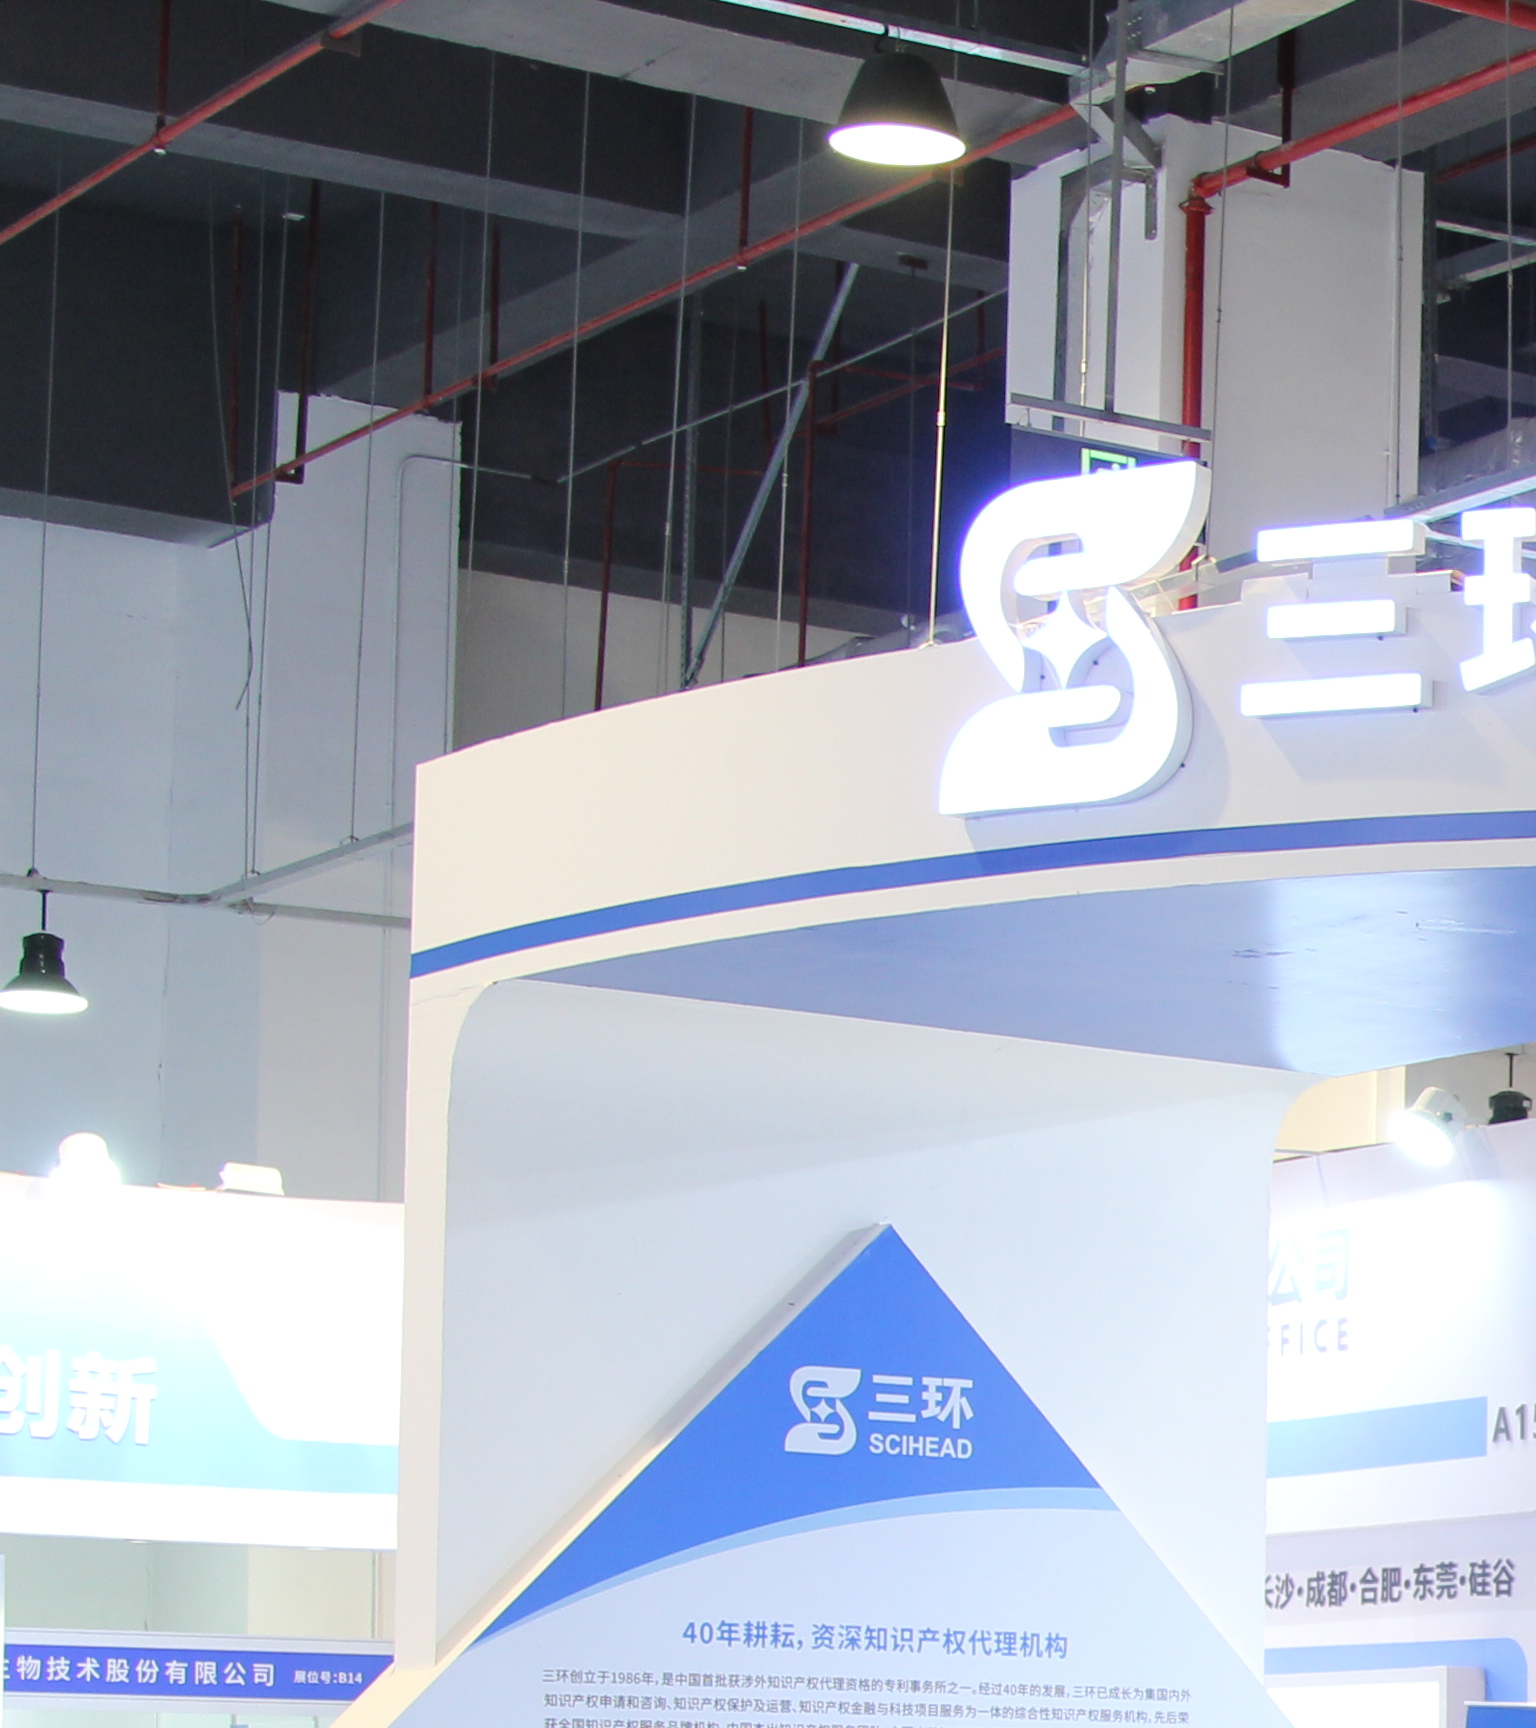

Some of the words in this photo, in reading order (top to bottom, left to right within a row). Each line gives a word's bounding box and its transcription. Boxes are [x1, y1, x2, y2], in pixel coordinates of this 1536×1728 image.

[1266, 1316, 1350, 1358] FICE
[867, 1374, 975, 1430] 三环
[868, 1432, 974, 1460] SCIHEAD
[5, 1655, 276, 1687] 物技术股份有限公司
